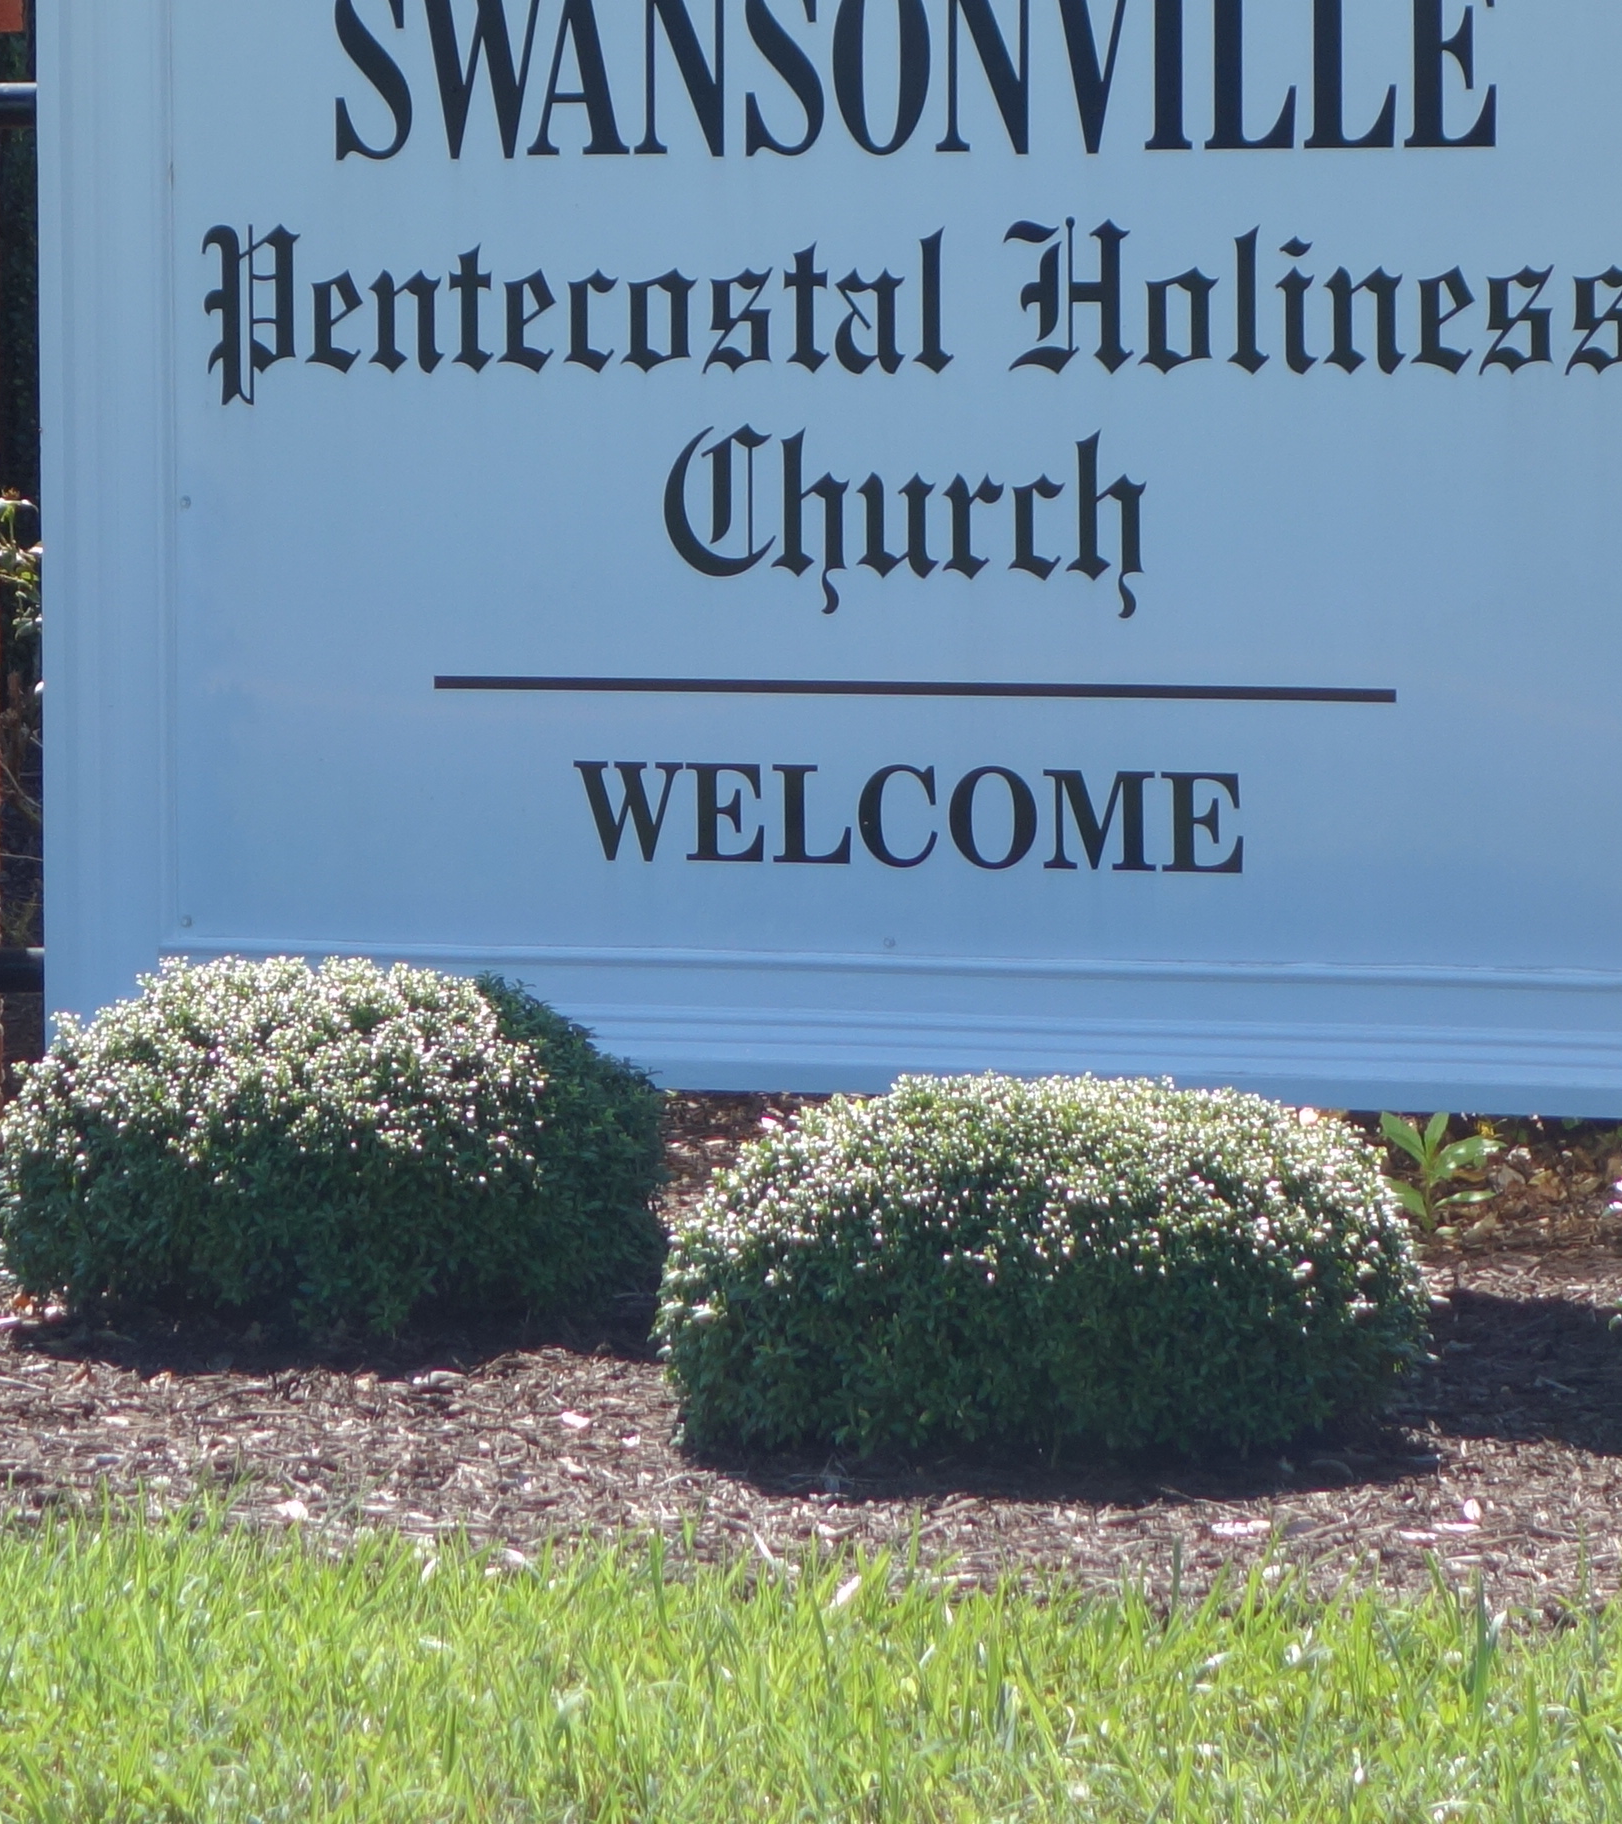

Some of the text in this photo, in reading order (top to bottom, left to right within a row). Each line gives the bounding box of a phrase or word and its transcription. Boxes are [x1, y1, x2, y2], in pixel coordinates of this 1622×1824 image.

[201, 224, 956, 407] Pentecostal
[663, 423, 1147, 619] Church
[572, 760, 1245, 874] WELCOME
